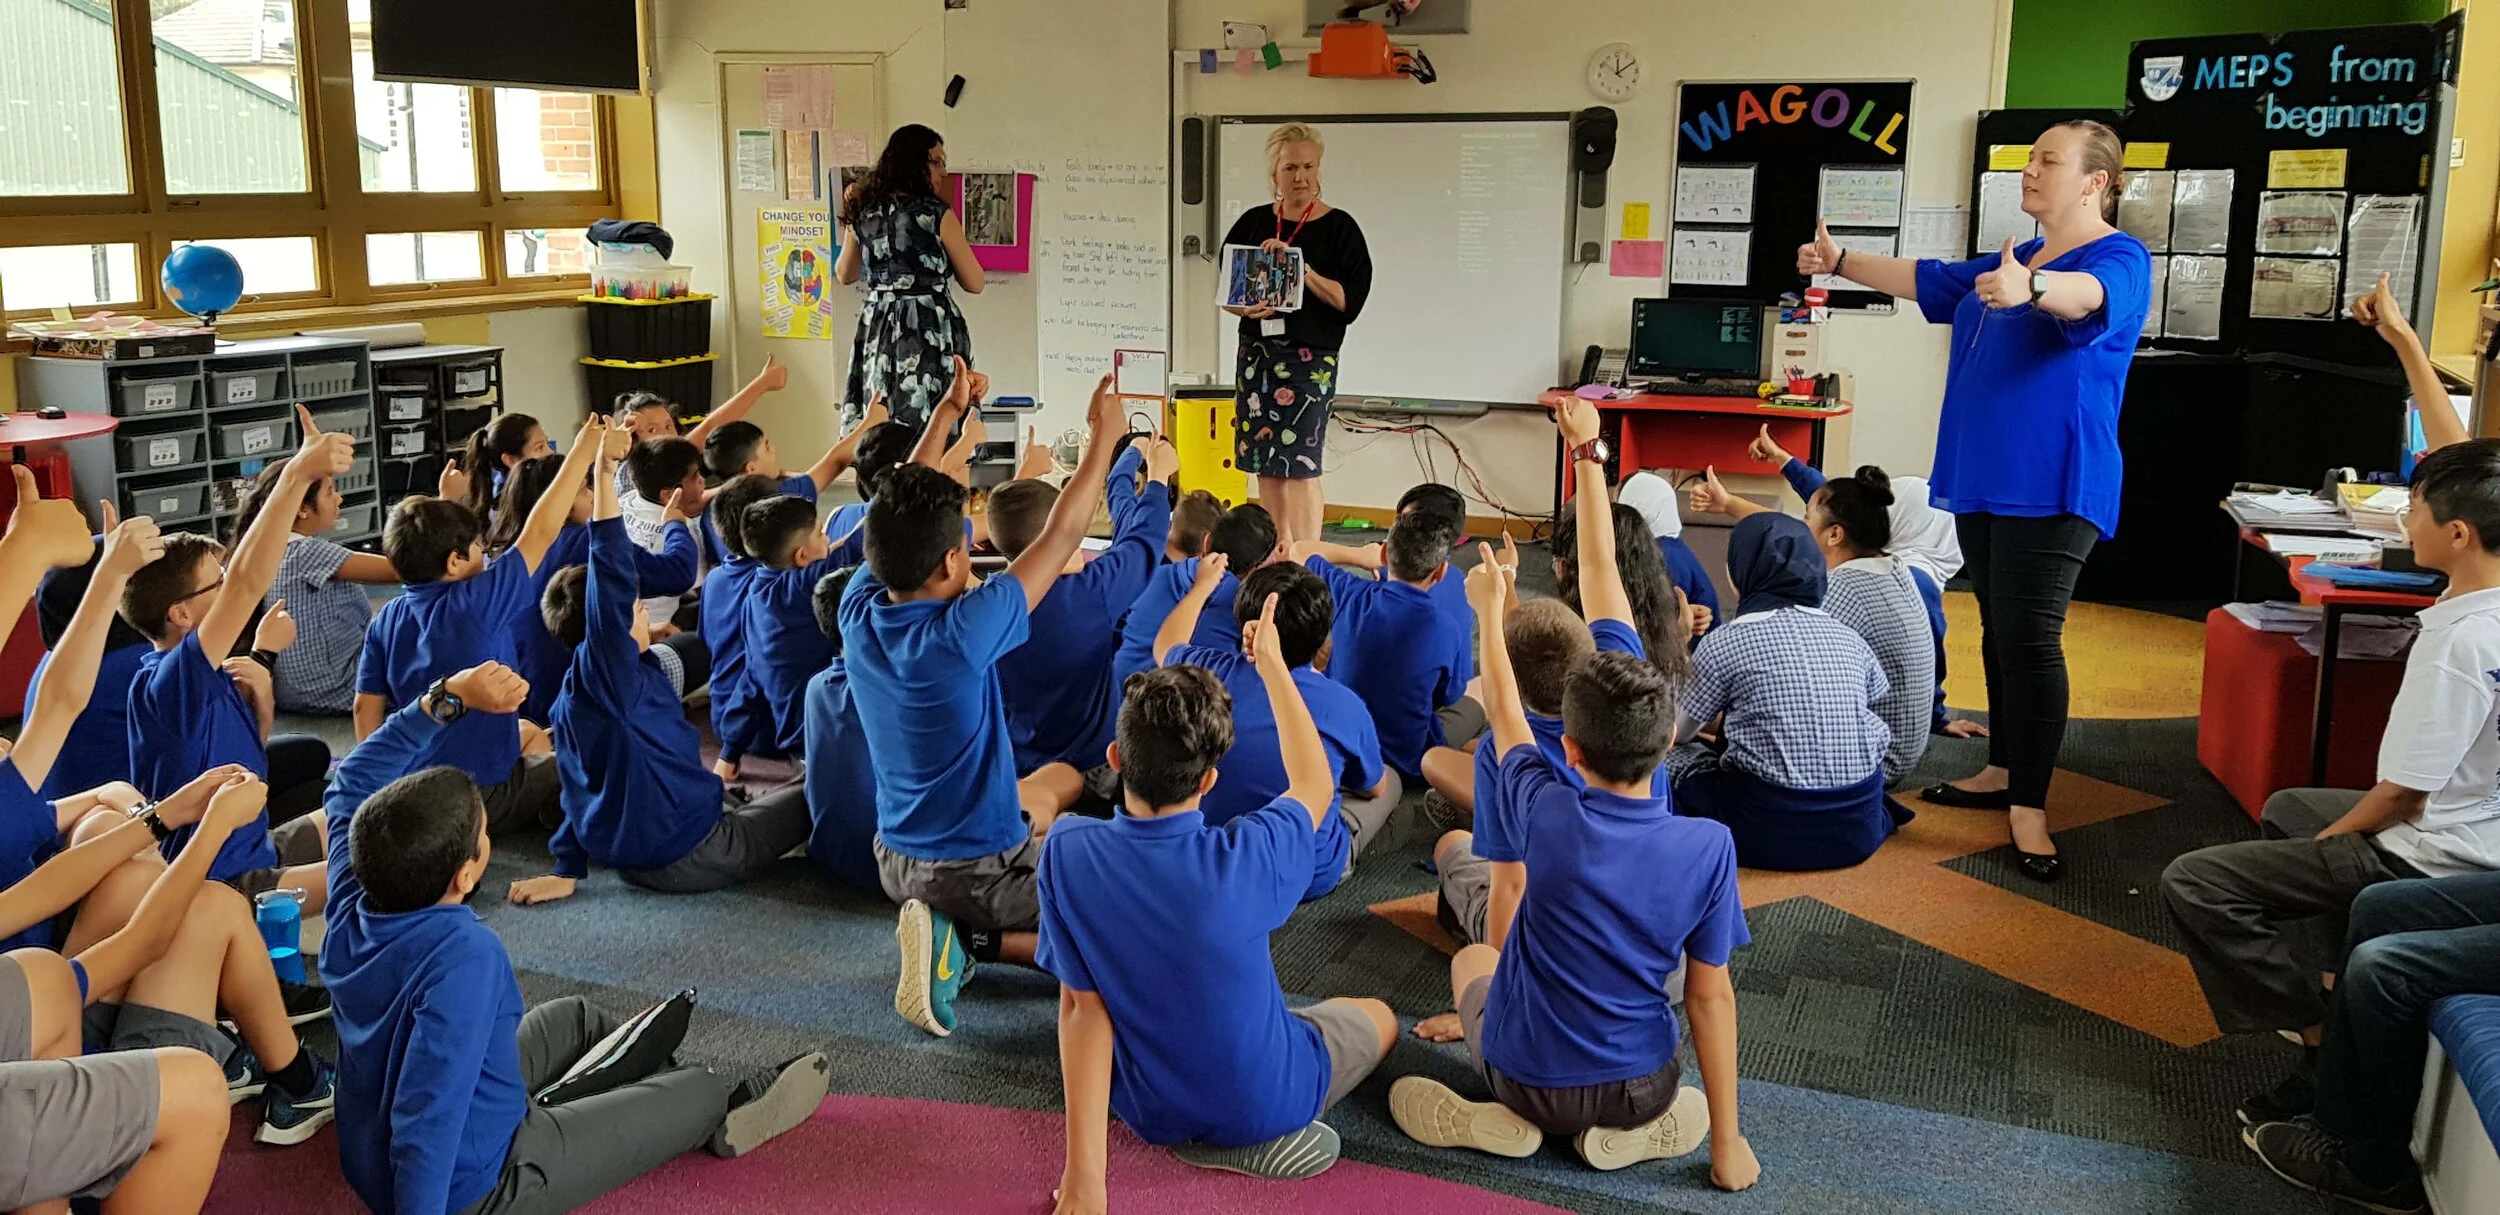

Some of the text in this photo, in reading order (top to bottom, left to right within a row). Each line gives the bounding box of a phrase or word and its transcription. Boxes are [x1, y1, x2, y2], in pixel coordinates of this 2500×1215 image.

[2193, 51, 2295, 91] MEPS
[2329, 43, 2417, 84] from
[1680, 84, 1905, 156] WAGOLL
[2265, 92, 2429, 137] beginning
[762, 211, 830, 222] CHANGE YOU
[780, 226, 824, 237] MINDSET
[637, 520, 663, 534] 2018
